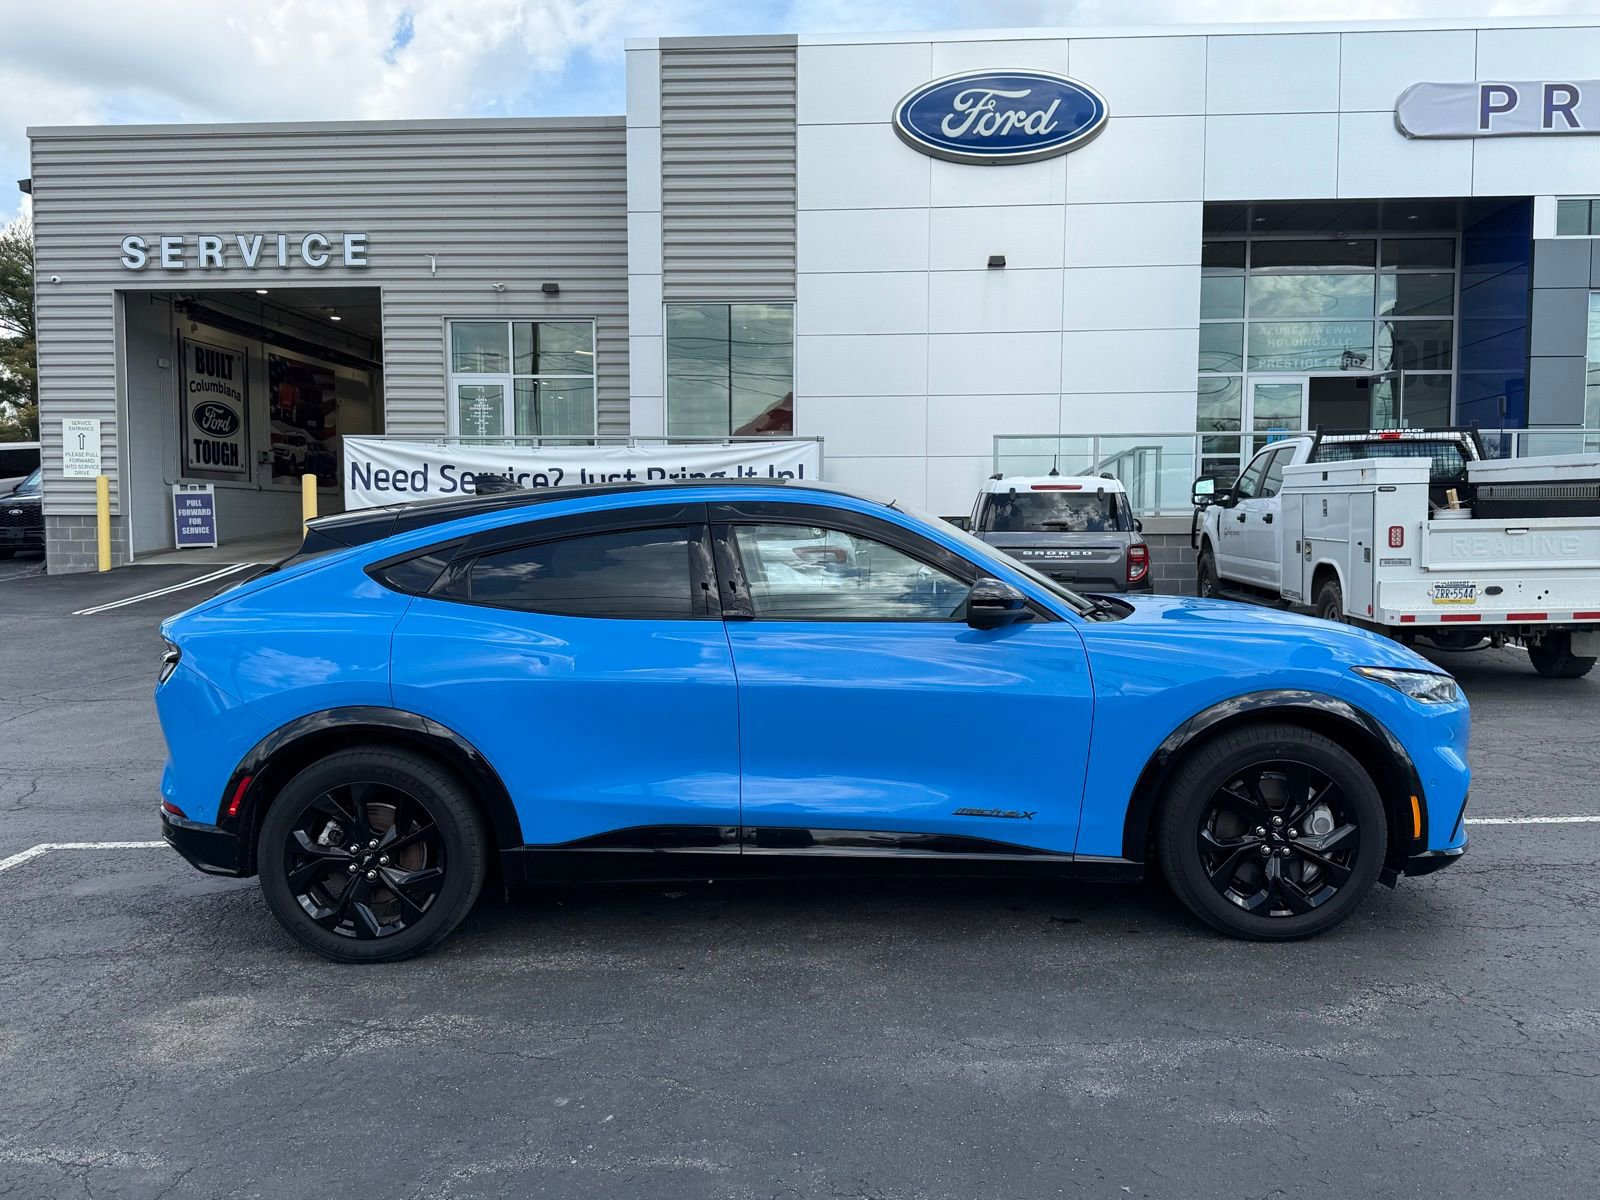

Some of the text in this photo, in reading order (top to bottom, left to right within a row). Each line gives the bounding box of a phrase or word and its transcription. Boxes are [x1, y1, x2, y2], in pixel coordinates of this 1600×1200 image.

[939, 87, 1061, 140] Ford
[120, 232, 370, 270] SERVICE
[1303, 326, 1358, 335] GATEWAY
[1267, 338, 1353, 347] HOLDINGS LLC
[194, 346, 234, 381] BUILT
[1258, 357, 1361, 368] PRESTIGE FORD
[189, 379, 242, 402] Columbiana
[202, 405, 231, 432] Ford
[193, 438, 239, 467] TOUGH
[351, 461, 428, 492] Need
[439, 464, 564, 494] Seice?
[178, 508, 212, 516] FORWARD
[186, 499, 202, 507] PULL
[181, 526, 210, 535] SERVICE
[188, 517, 202, 525] FOR
[1451, 535, 1580, 557] READING
